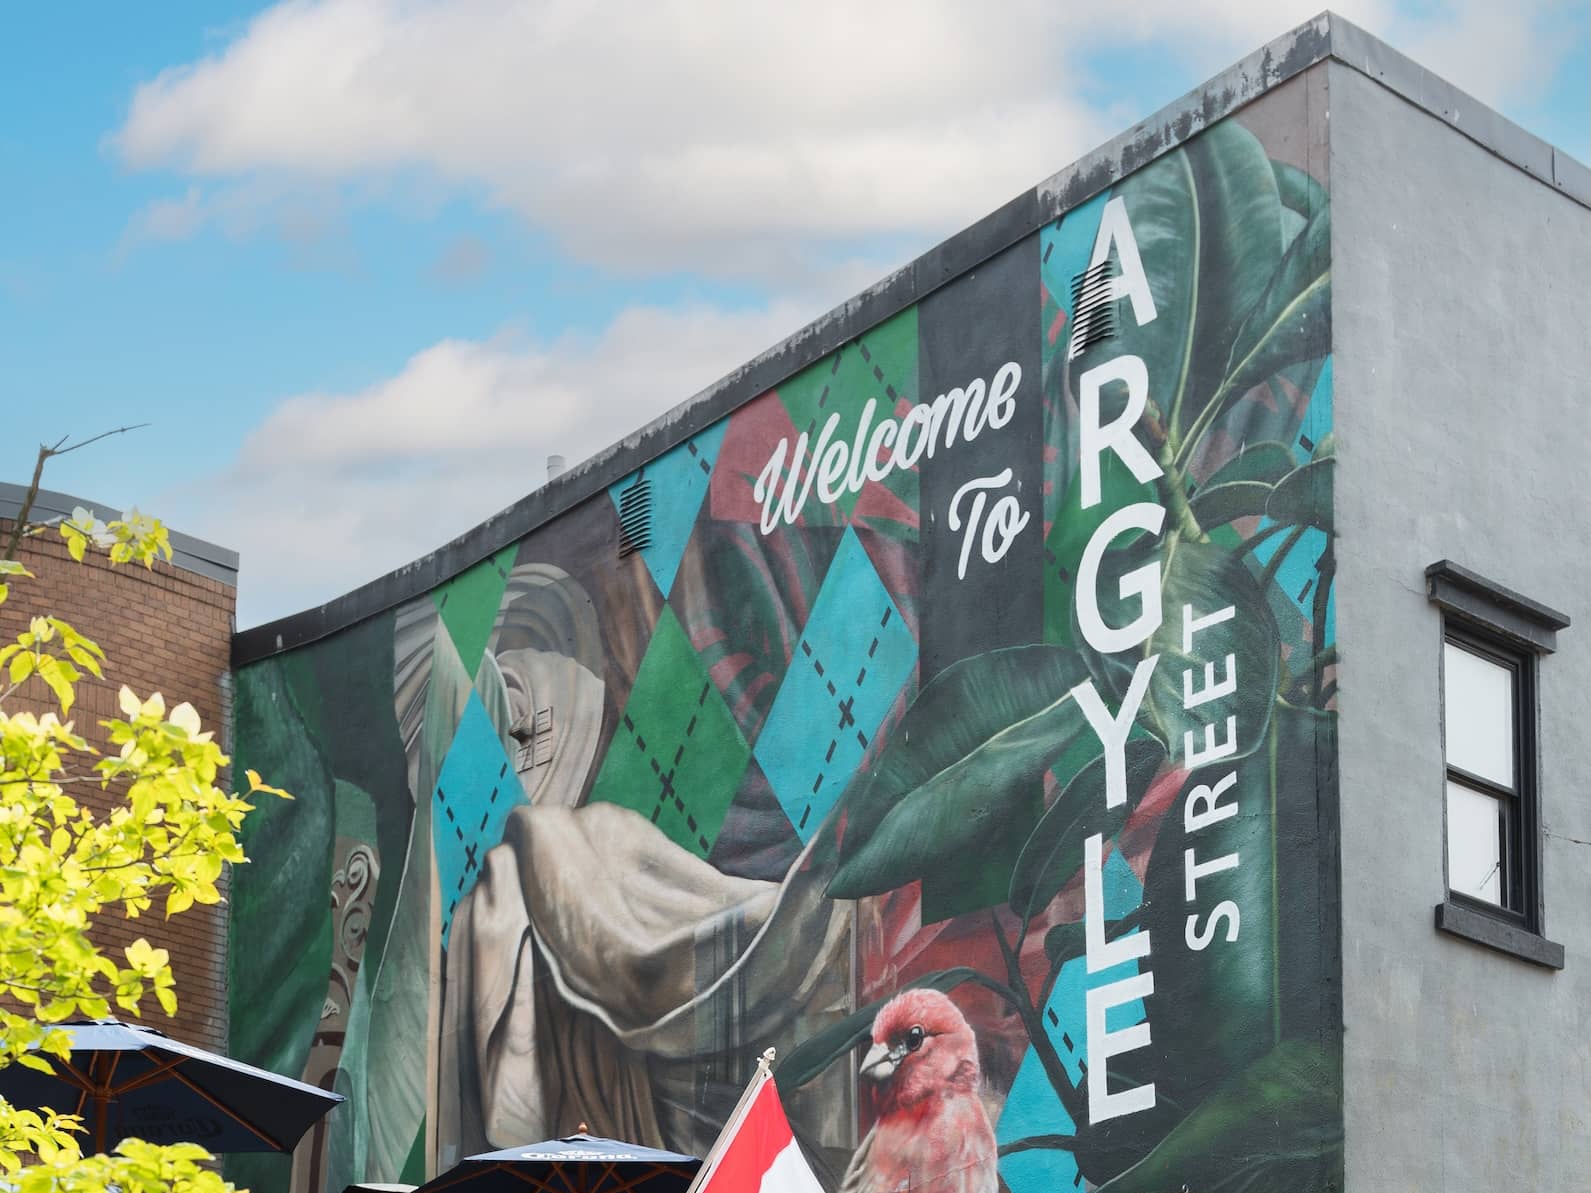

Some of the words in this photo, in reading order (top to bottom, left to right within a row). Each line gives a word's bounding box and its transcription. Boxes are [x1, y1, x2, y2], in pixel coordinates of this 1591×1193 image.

[753, 361, 1022, 536] Welcome
[949, 467, 1031, 580] To
[1068, 195, 1167, 1126] ARGYLE
[1182, 602, 1241, 952] STREET
